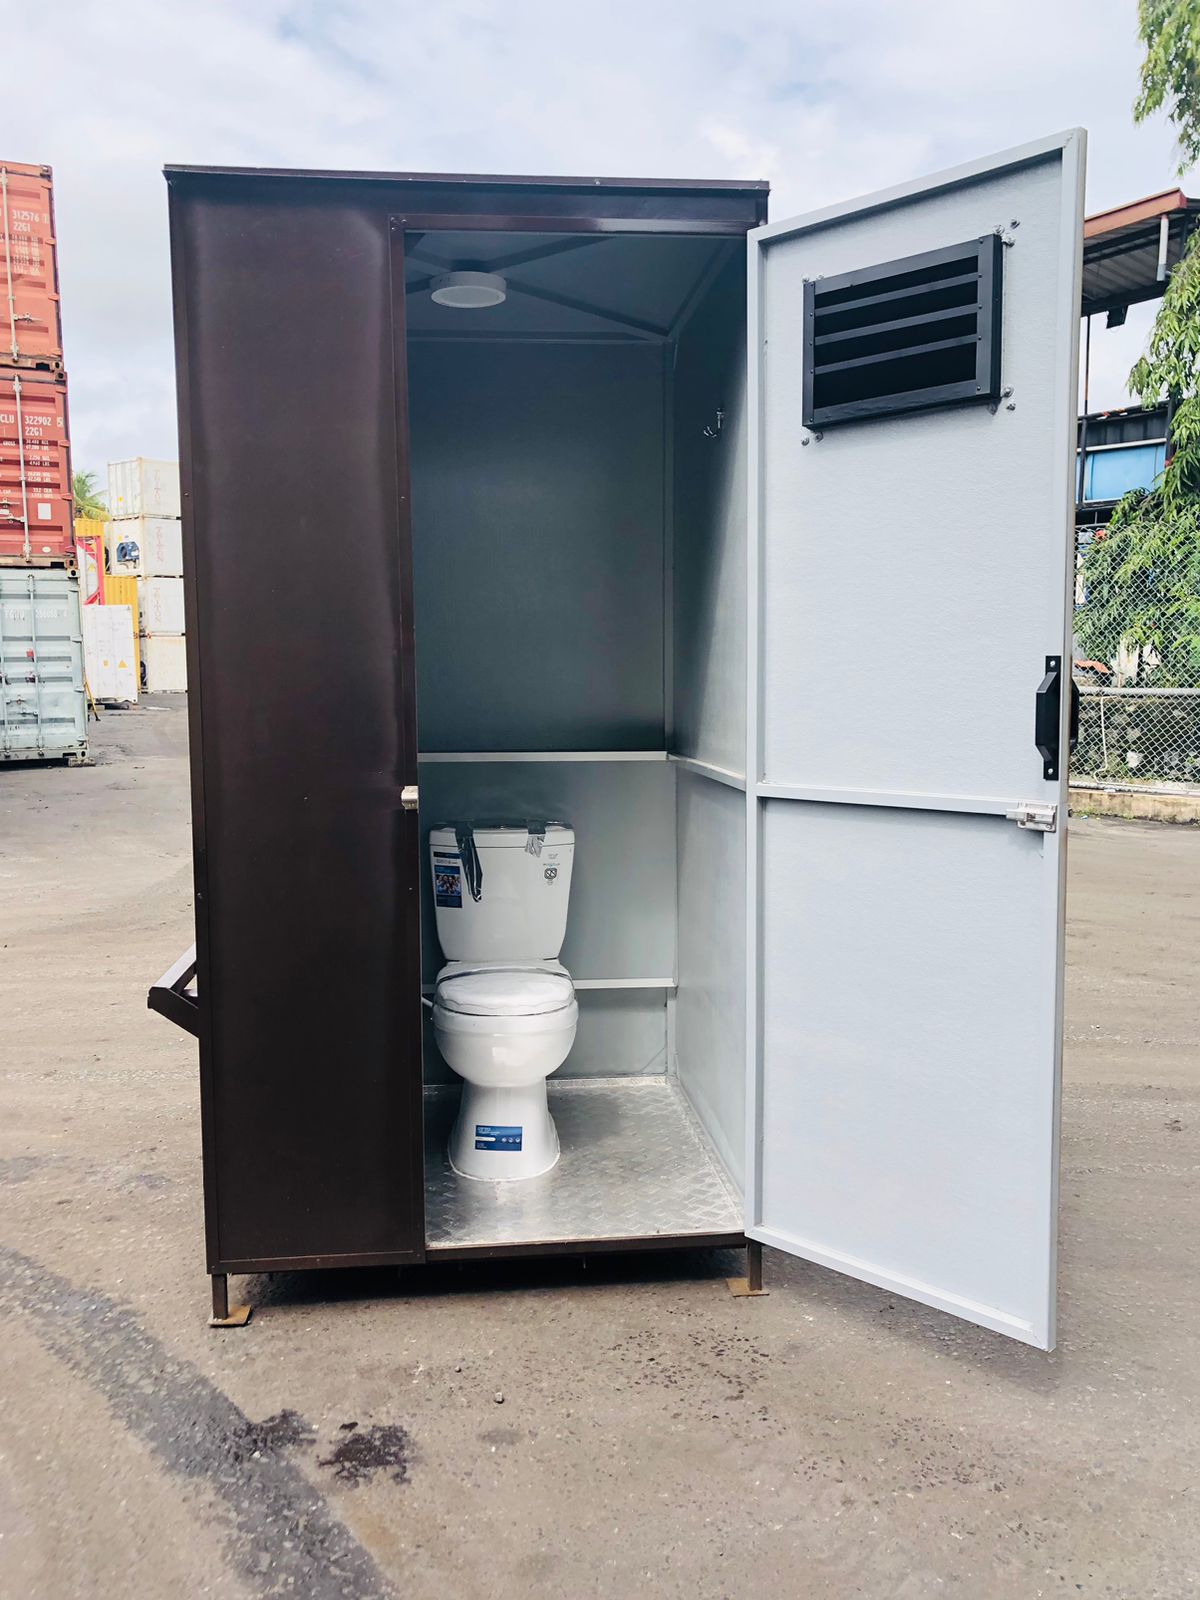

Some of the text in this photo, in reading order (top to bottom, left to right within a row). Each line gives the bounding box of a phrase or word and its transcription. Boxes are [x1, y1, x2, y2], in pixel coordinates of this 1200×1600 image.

[12, 209, 40, 223] 312576
[24, 415, 52, 426] 322902
[25, 426, 43, 437] 22G1
